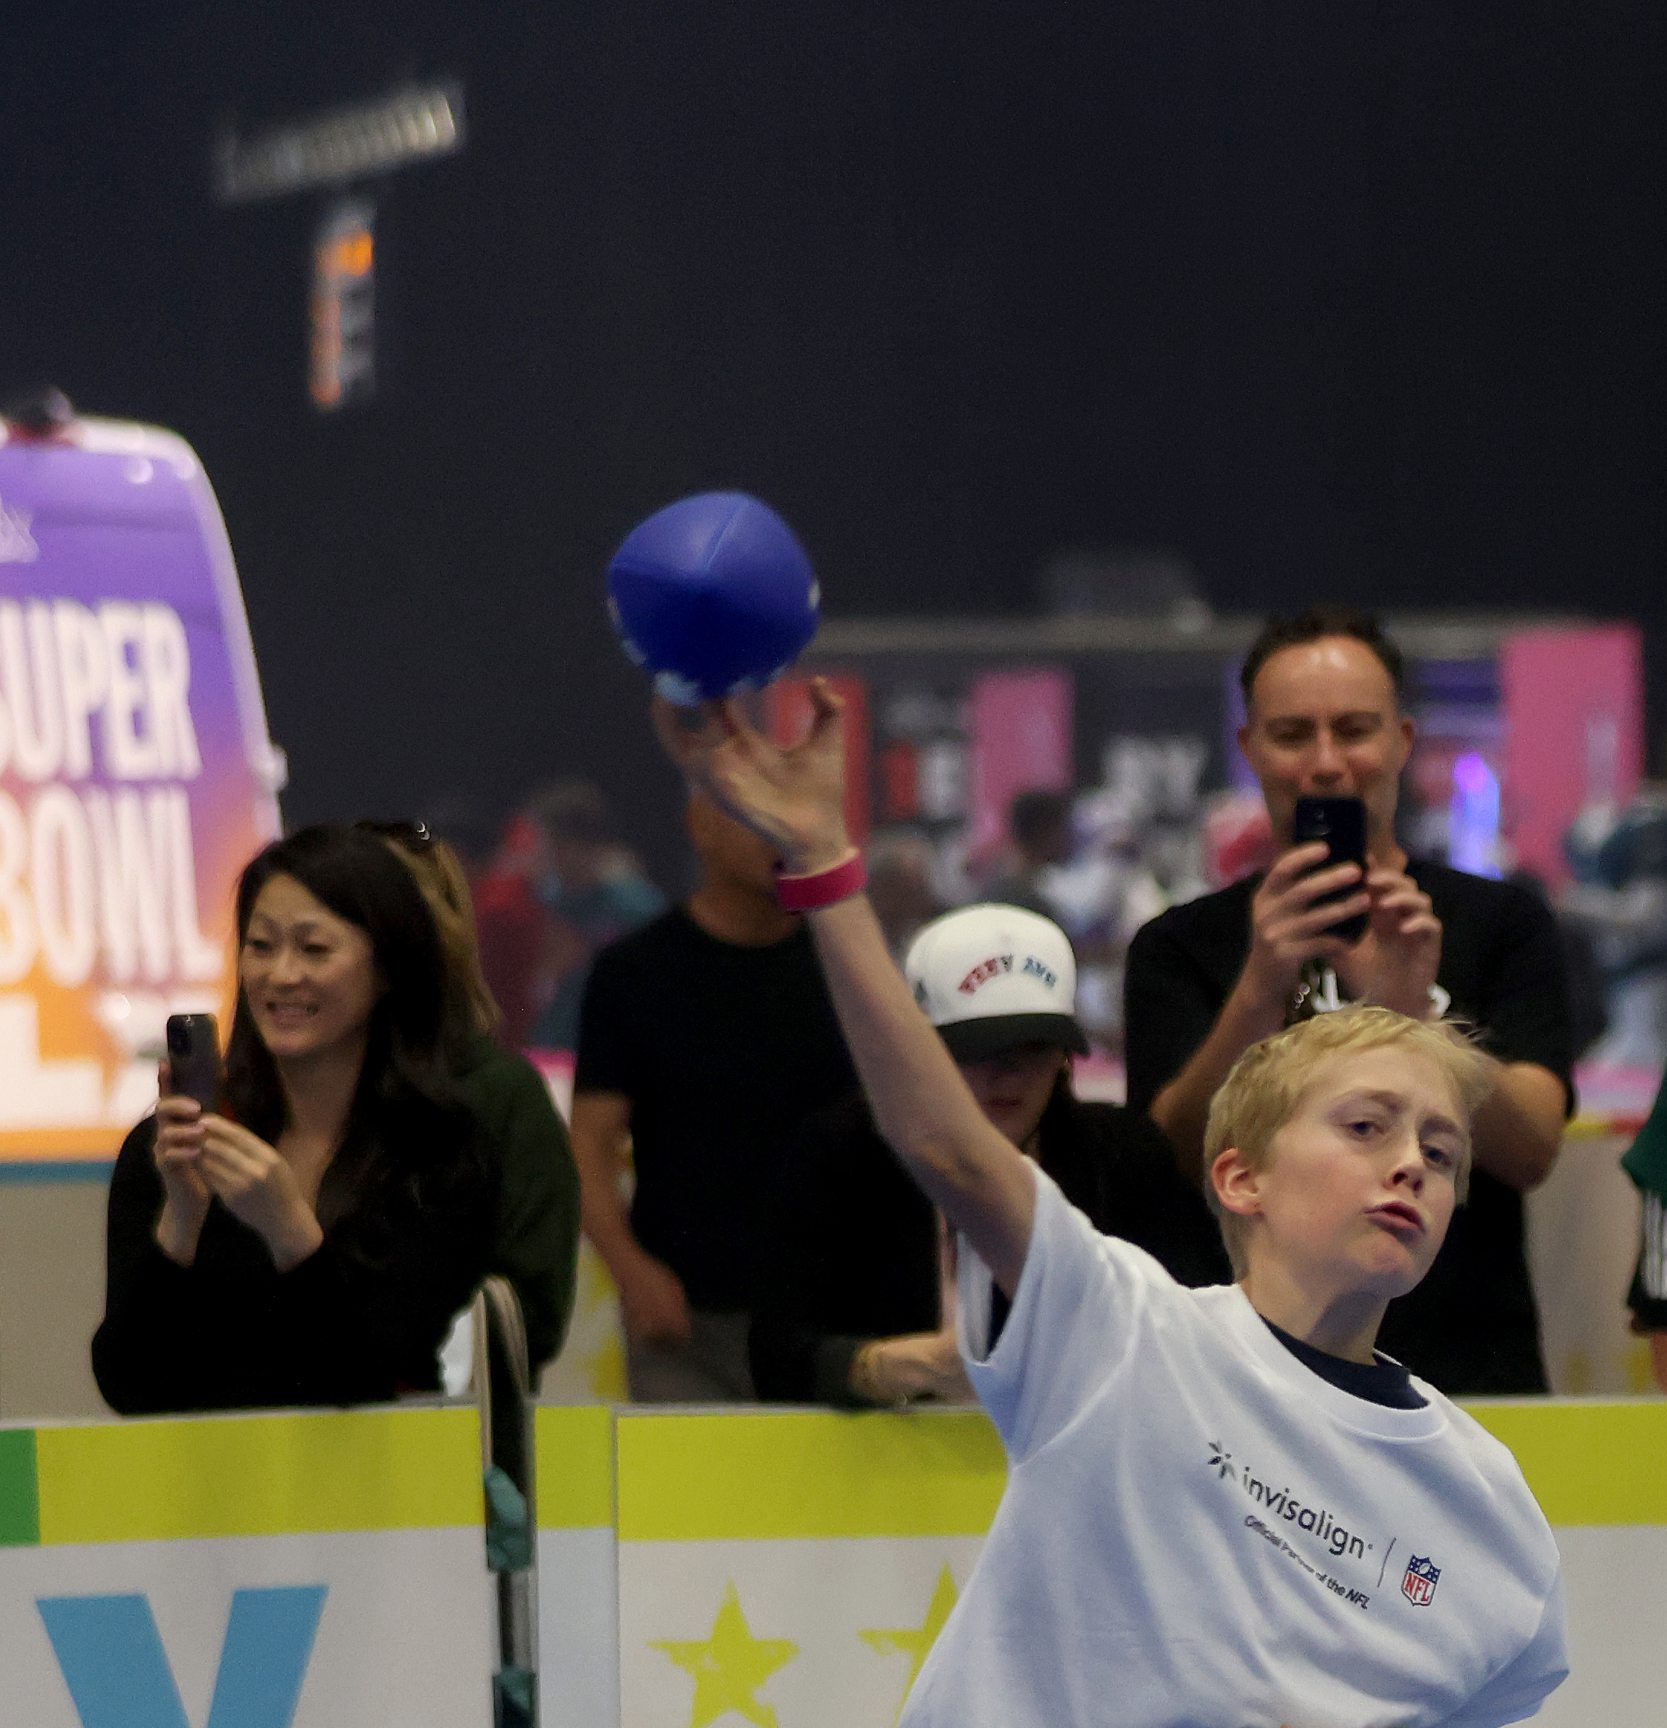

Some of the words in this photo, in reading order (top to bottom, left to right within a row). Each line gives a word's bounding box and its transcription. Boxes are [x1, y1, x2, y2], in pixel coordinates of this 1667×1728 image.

[0, 600, 201, 780] UPER
[1243, 1466, 1365, 1558] invisalign
[1344, 1588, 1371, 1611] NFL
[1403, 1571, 1433, 1604] NFL
